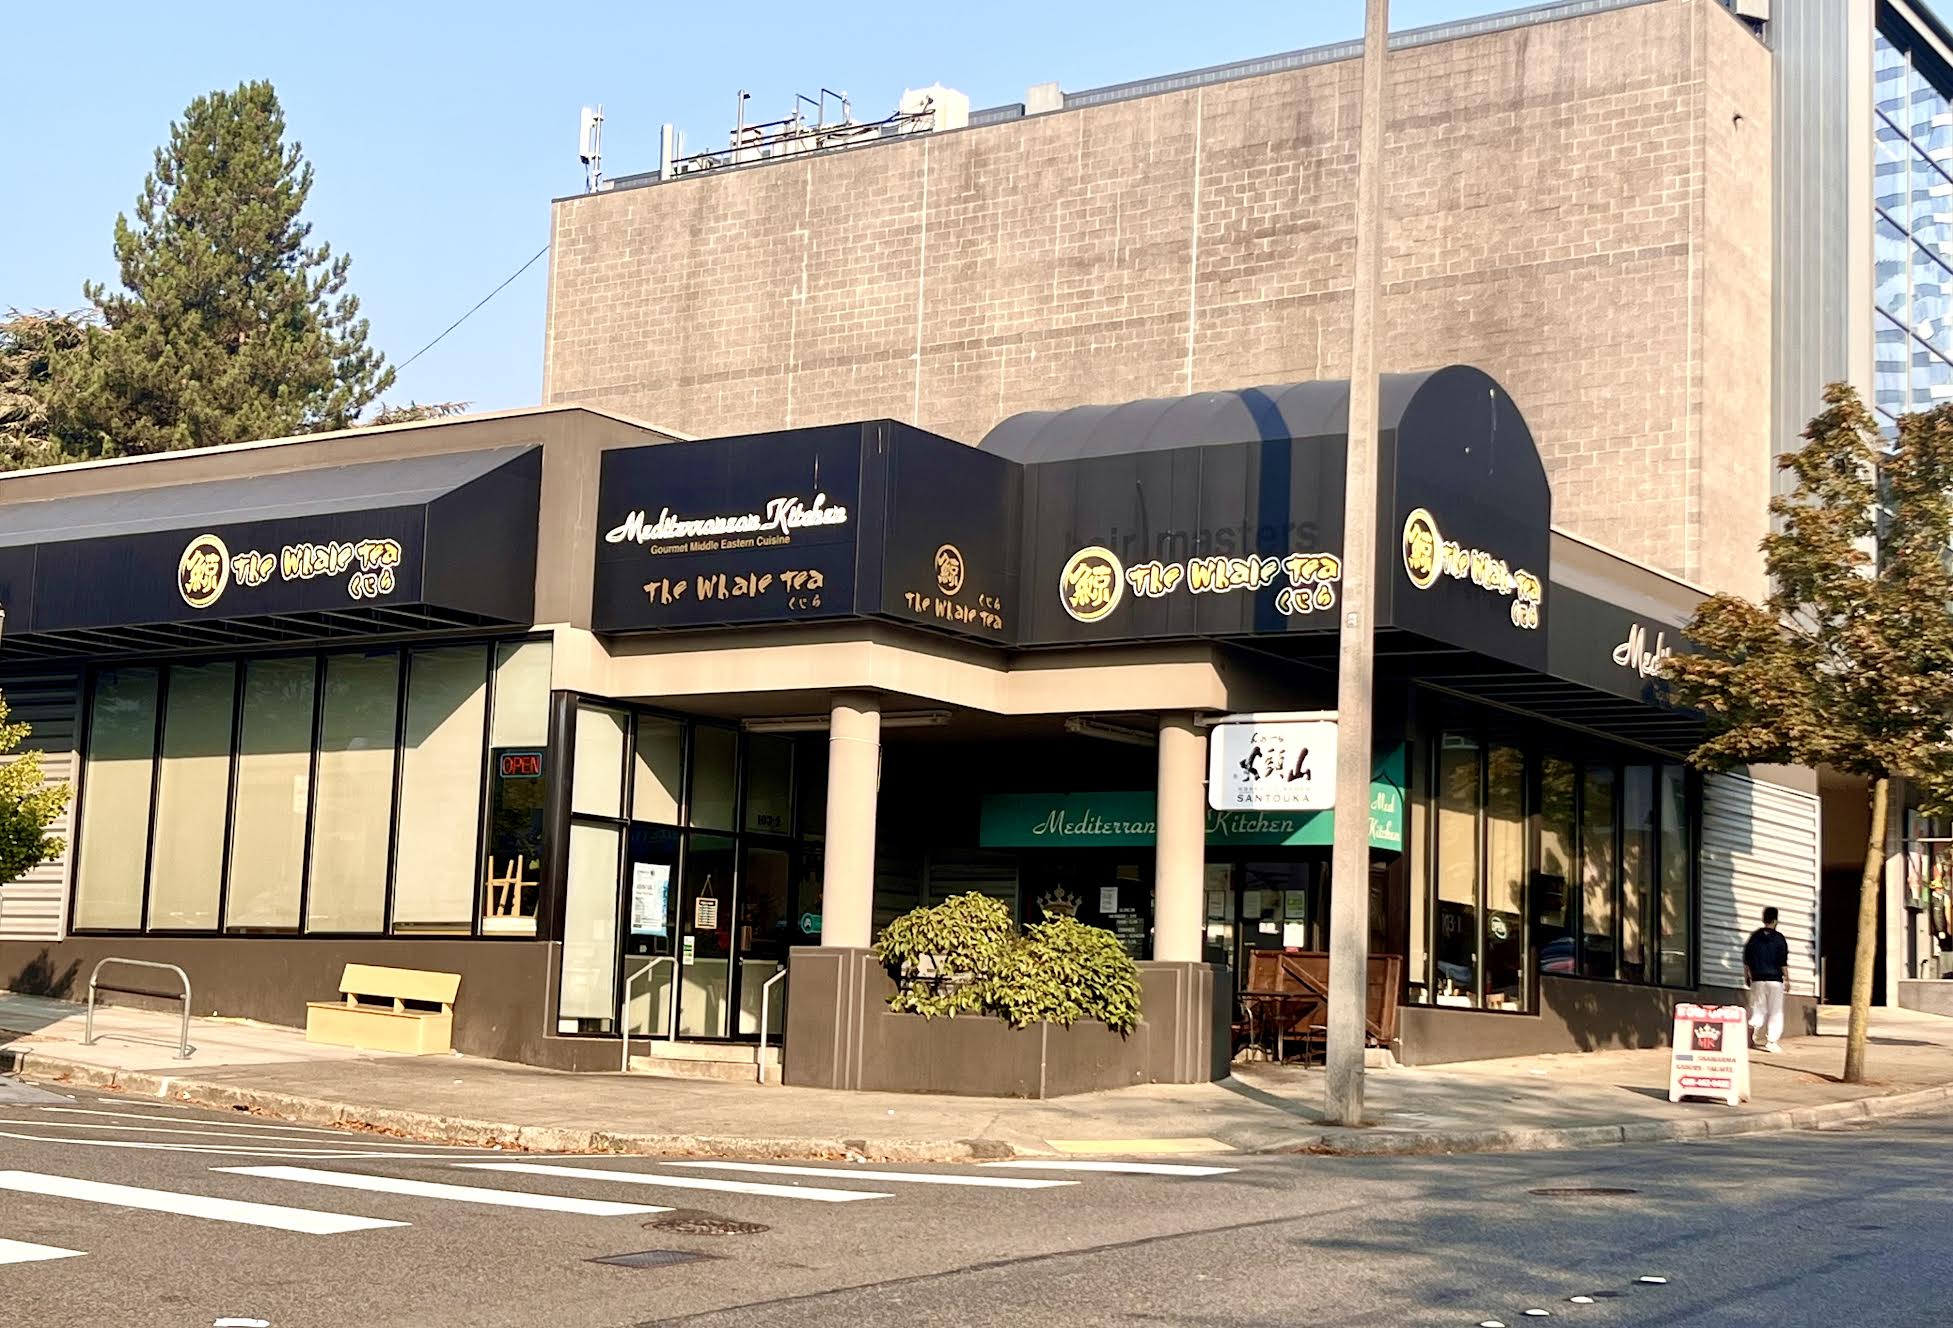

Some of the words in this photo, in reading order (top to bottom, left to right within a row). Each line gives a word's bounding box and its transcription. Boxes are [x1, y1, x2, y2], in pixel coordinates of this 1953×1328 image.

[605, 507, 761, 544] Mediterranean
[765, 492, 848, 535] Kitchen
[650, 543, 688, 555] Gourmet
[690, 540, 719, 552] Middle
[720, 537, 755, 549] Eastern
[756, 535, 791, 547] Cuisine
[231, 550, 277, 586] The
[281, 541, 353, 581] Whale
[354, 538, 401, 571] Tea
[1126, 560, 1184, 598] The
[1187, 554, 1281, 593] Whale
[1281, 552, 1341, 585] Tea
[643, 577, 688, 605] The
[697, 572, 773, 601] Whale
[779, 569, 824, 593] Tea
[904, 591, 931, 613] The
[935, 598, 977, 624] Whale
[979, 611, 1003, 630] Tea
[502, 755, 540, 775] OPEN
[1237, 794, 1310, 803] SANTOUKA
[1370, 792, 1396, 813] Med
[1033, 809, 1156, 836] Mediterran
[1206, 808, 1296, 836] Kitchen
